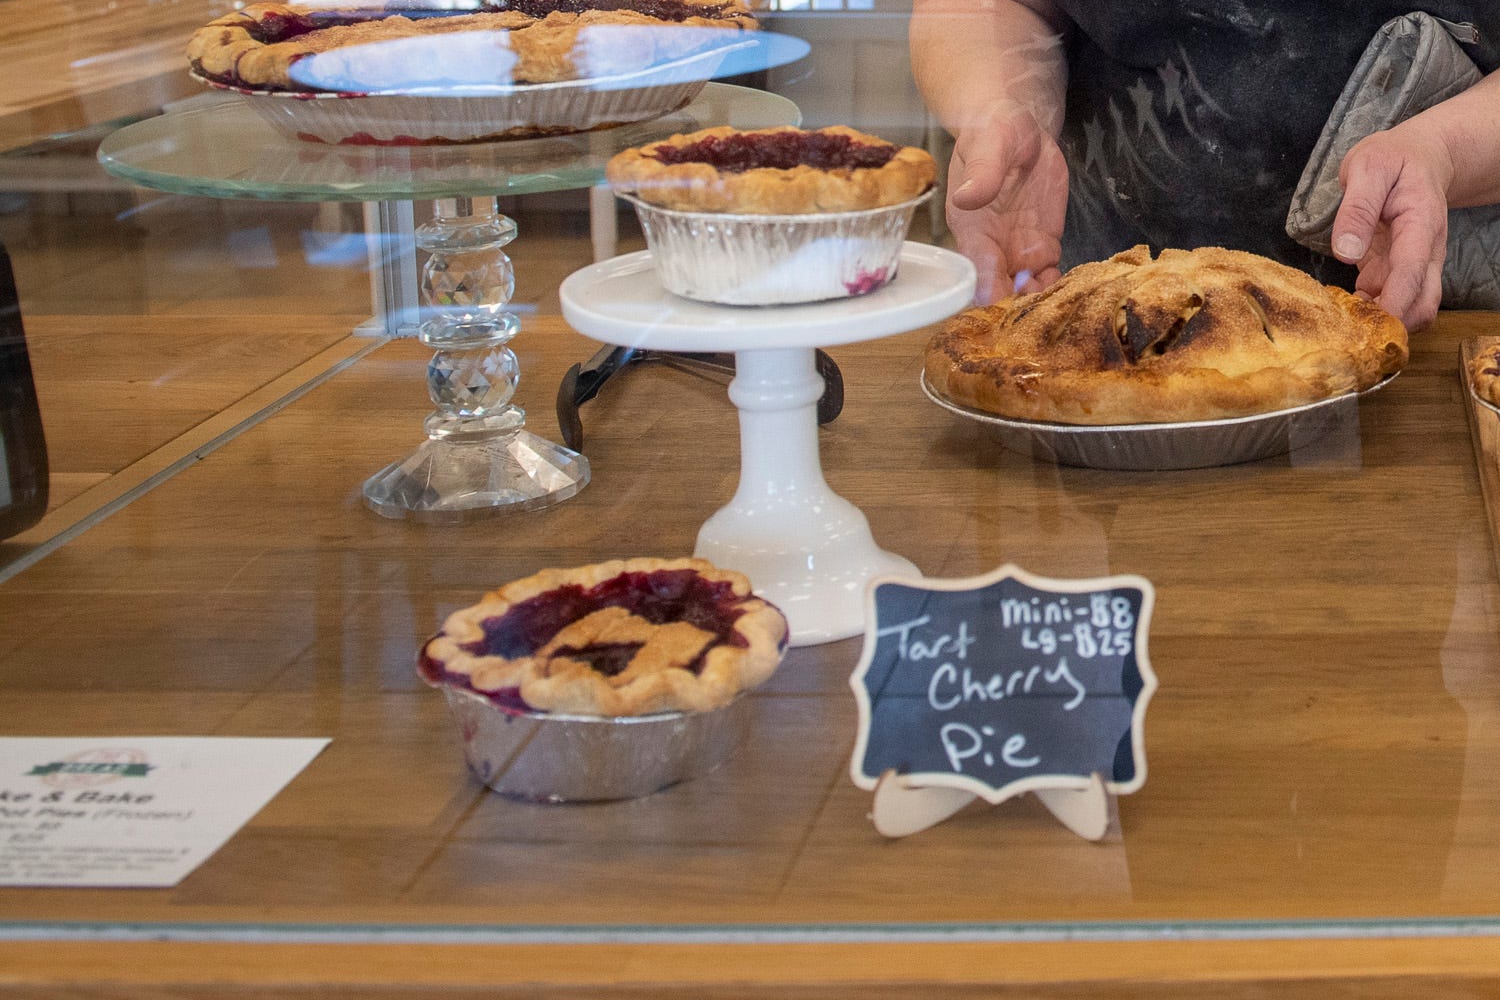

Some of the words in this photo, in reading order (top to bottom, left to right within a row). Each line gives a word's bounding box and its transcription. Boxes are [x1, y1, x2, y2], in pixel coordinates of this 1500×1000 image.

[876, 614, 977, 661] Tart
[928, 656, 1086, 711] Cherry
[939, 721, 1041, 772] Pie
